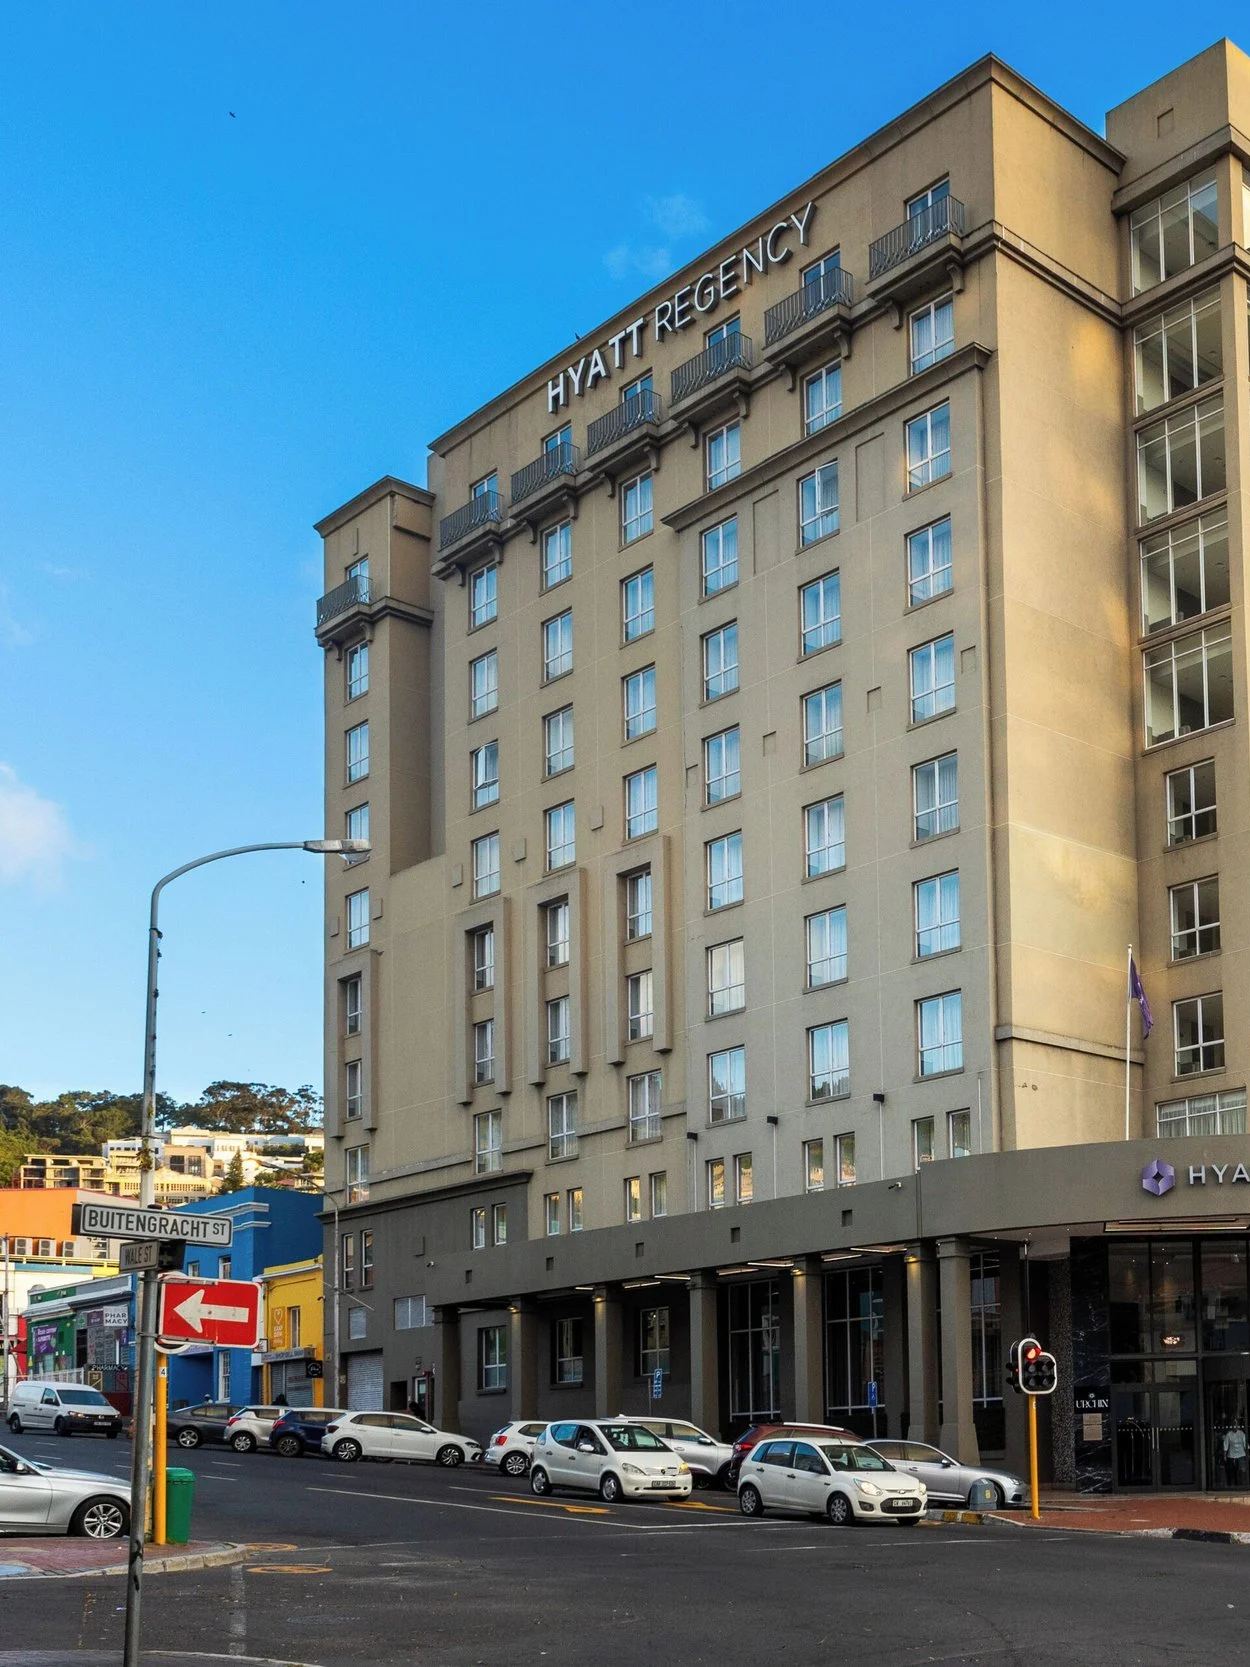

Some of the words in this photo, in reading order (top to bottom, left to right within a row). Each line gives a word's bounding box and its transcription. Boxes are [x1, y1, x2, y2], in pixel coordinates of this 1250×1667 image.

[547, 317, 647, 413] HYATT
[655, 202, 817, 341] REGENCY
[88, 1209, 210, 1239] BUITENGRACHT
[213, 1222, 227, 1236] ST
[125, 1246, 143, 1265] WALE
[144, 1245, 153, 1262] ST
[1075, 1399, 1109, 1408] URCHIN
